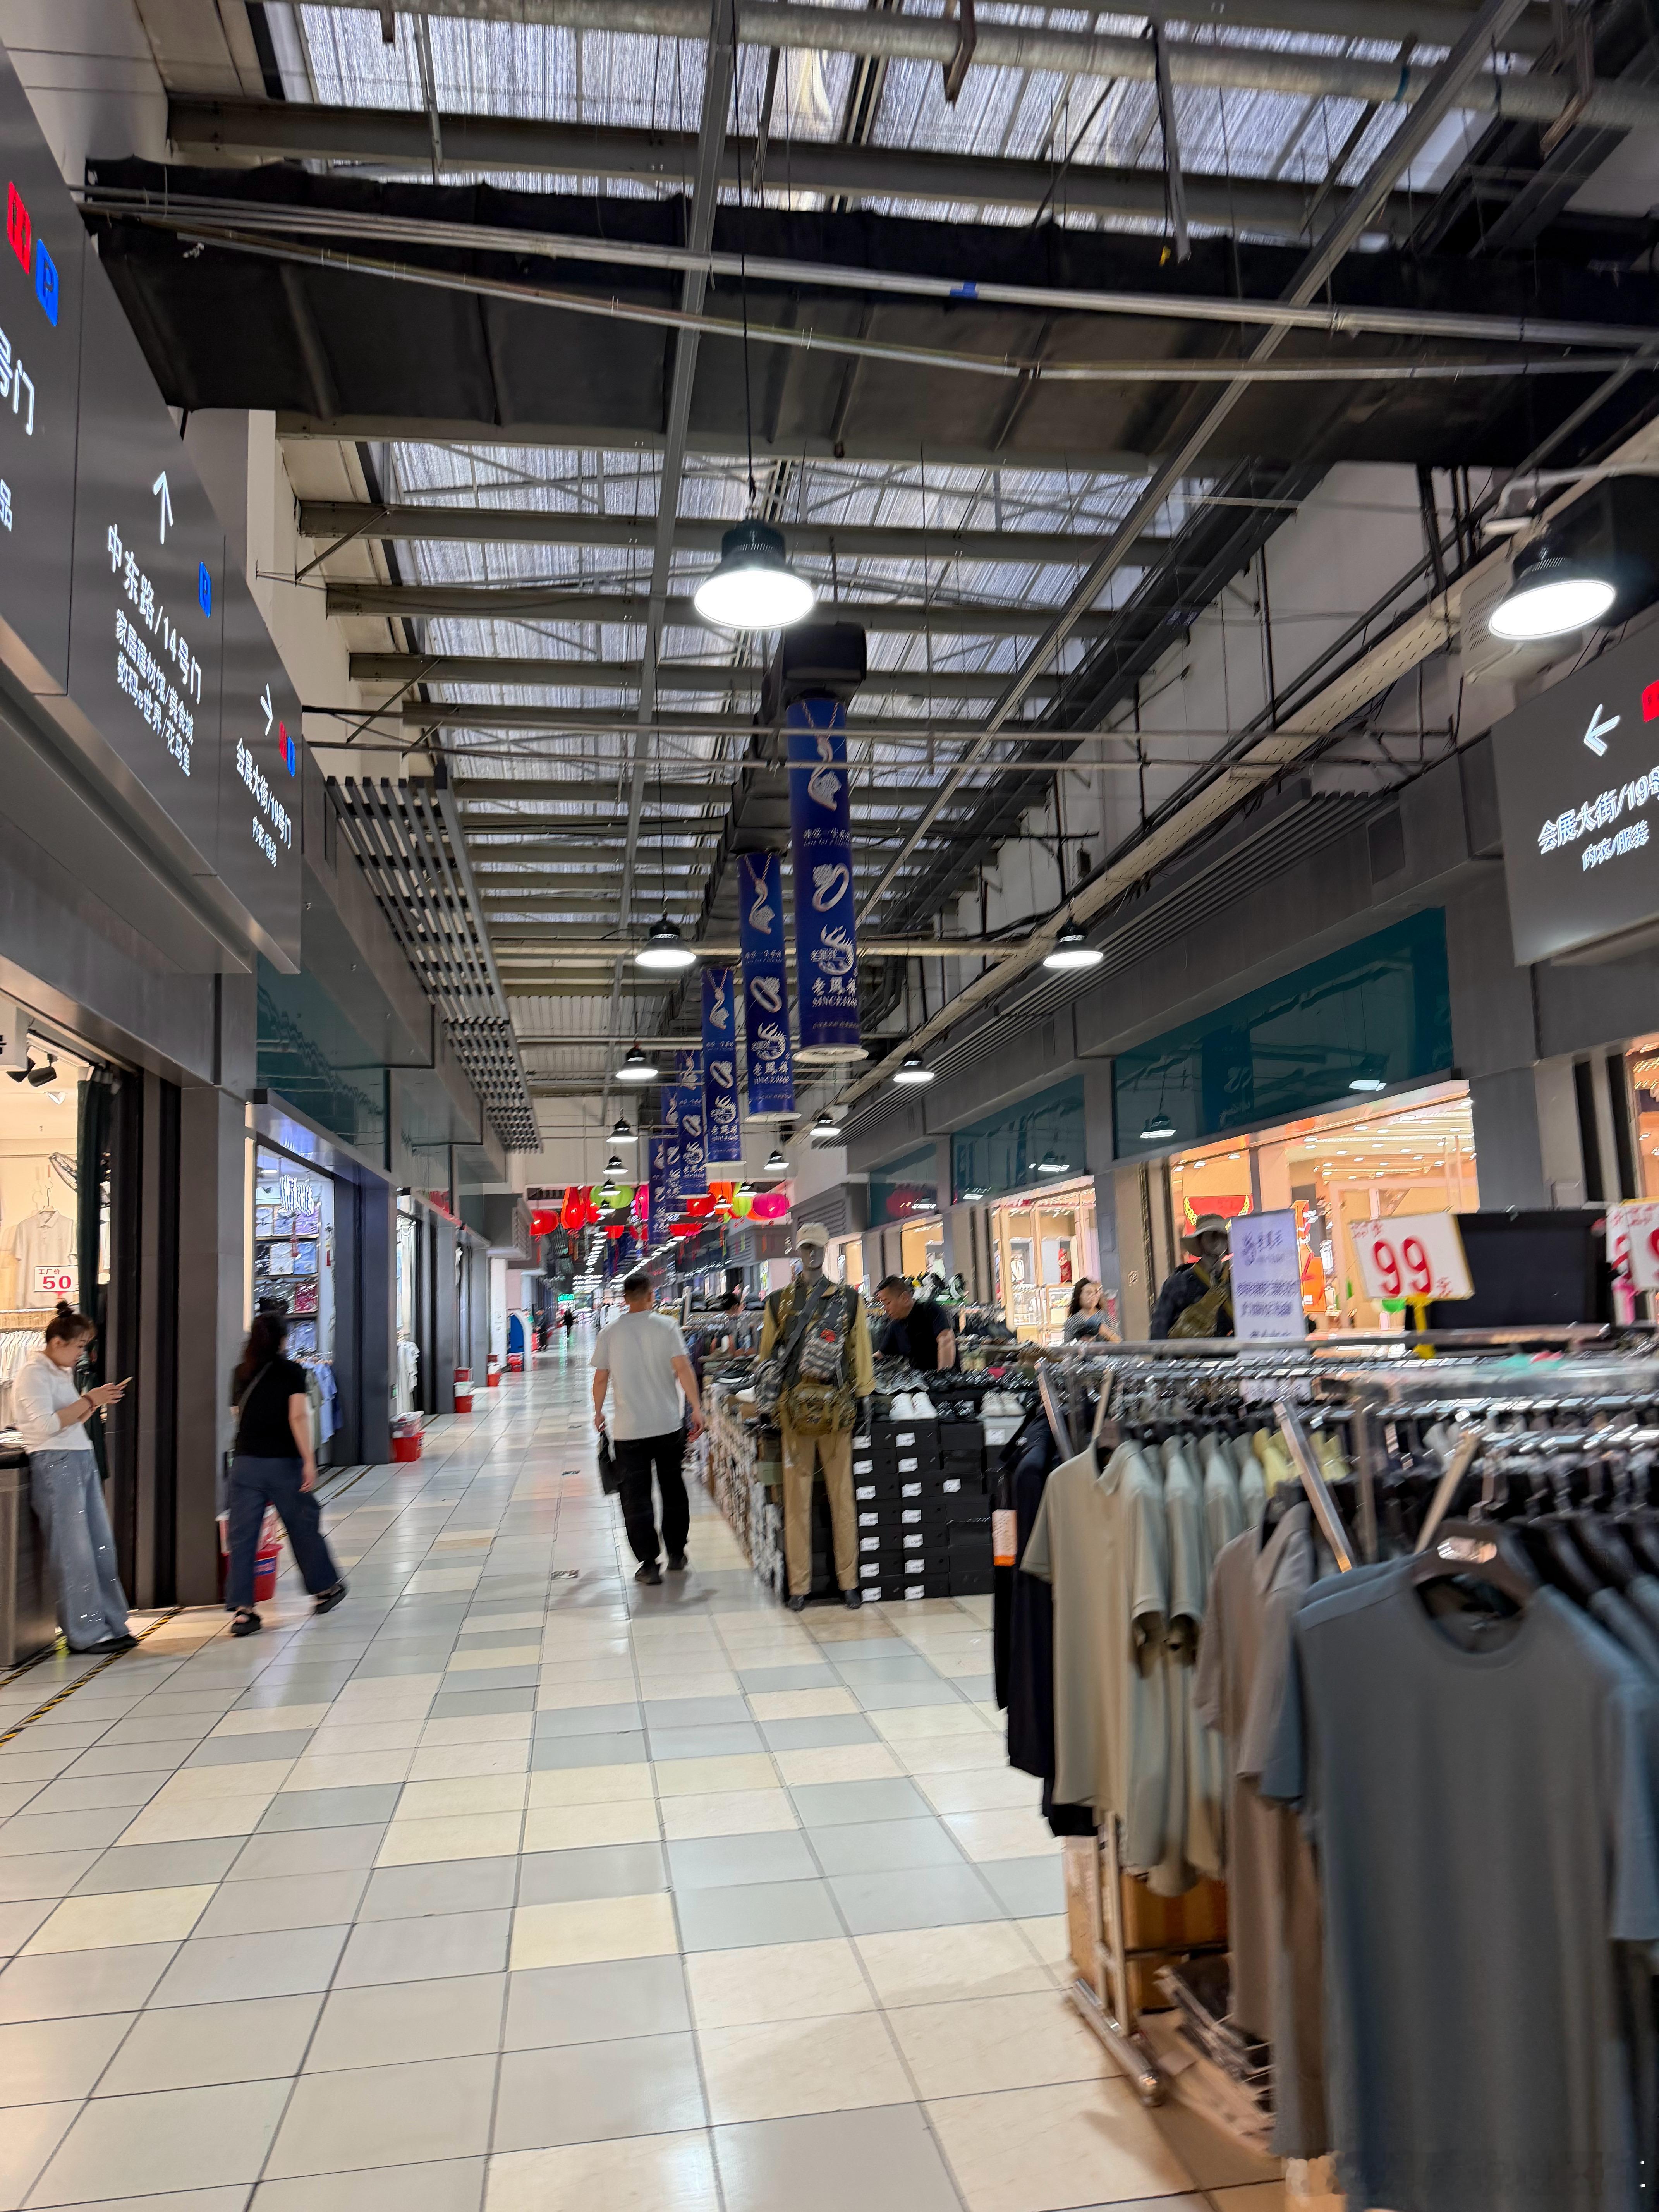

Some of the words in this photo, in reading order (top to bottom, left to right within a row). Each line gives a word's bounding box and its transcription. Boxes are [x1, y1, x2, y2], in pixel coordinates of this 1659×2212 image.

[108, 524, 201, 704] 中东路/14号门
[236, 738, 292, 850] 会展大街/19号门
[1582, 819, 1649, 871] 内衣/服装
[43, 1276, 71, 1289] 50
[1372, 1237, 1431, 1295] 99
